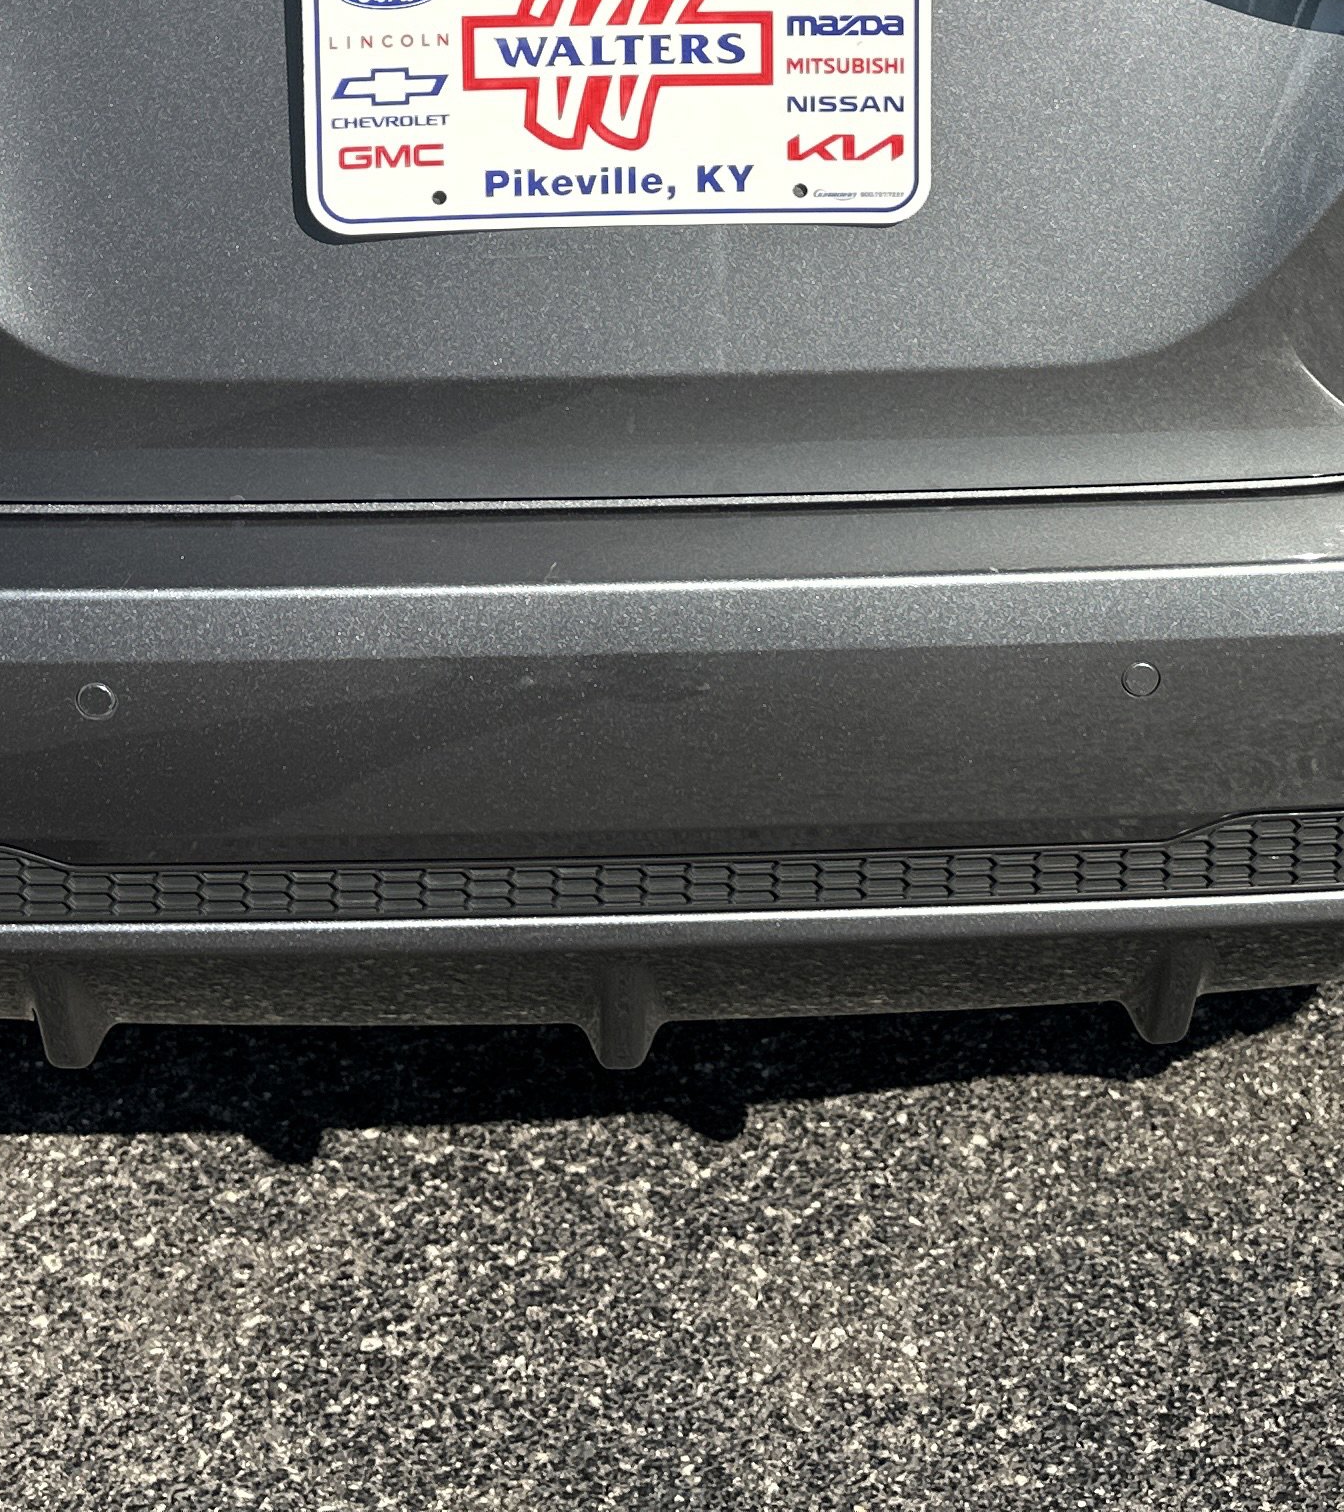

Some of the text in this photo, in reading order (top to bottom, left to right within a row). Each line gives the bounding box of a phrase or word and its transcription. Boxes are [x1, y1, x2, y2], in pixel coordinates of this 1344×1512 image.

[786, 14, 905, 37] mazda
[329, 32, 450, 50] LINCOLN
[493, 33, 746, 68] WALTERS
[786, 57, 905, 75] MITSUBISHI
[786, 95, 905, 113] NISSAN
[330, 113, 451, 130] CHEVROLET
[338, 143, 445, 170] GMC
[786, 134, 905, 162] KIA
[484, 164, 755, 200] Pikeville, KY
